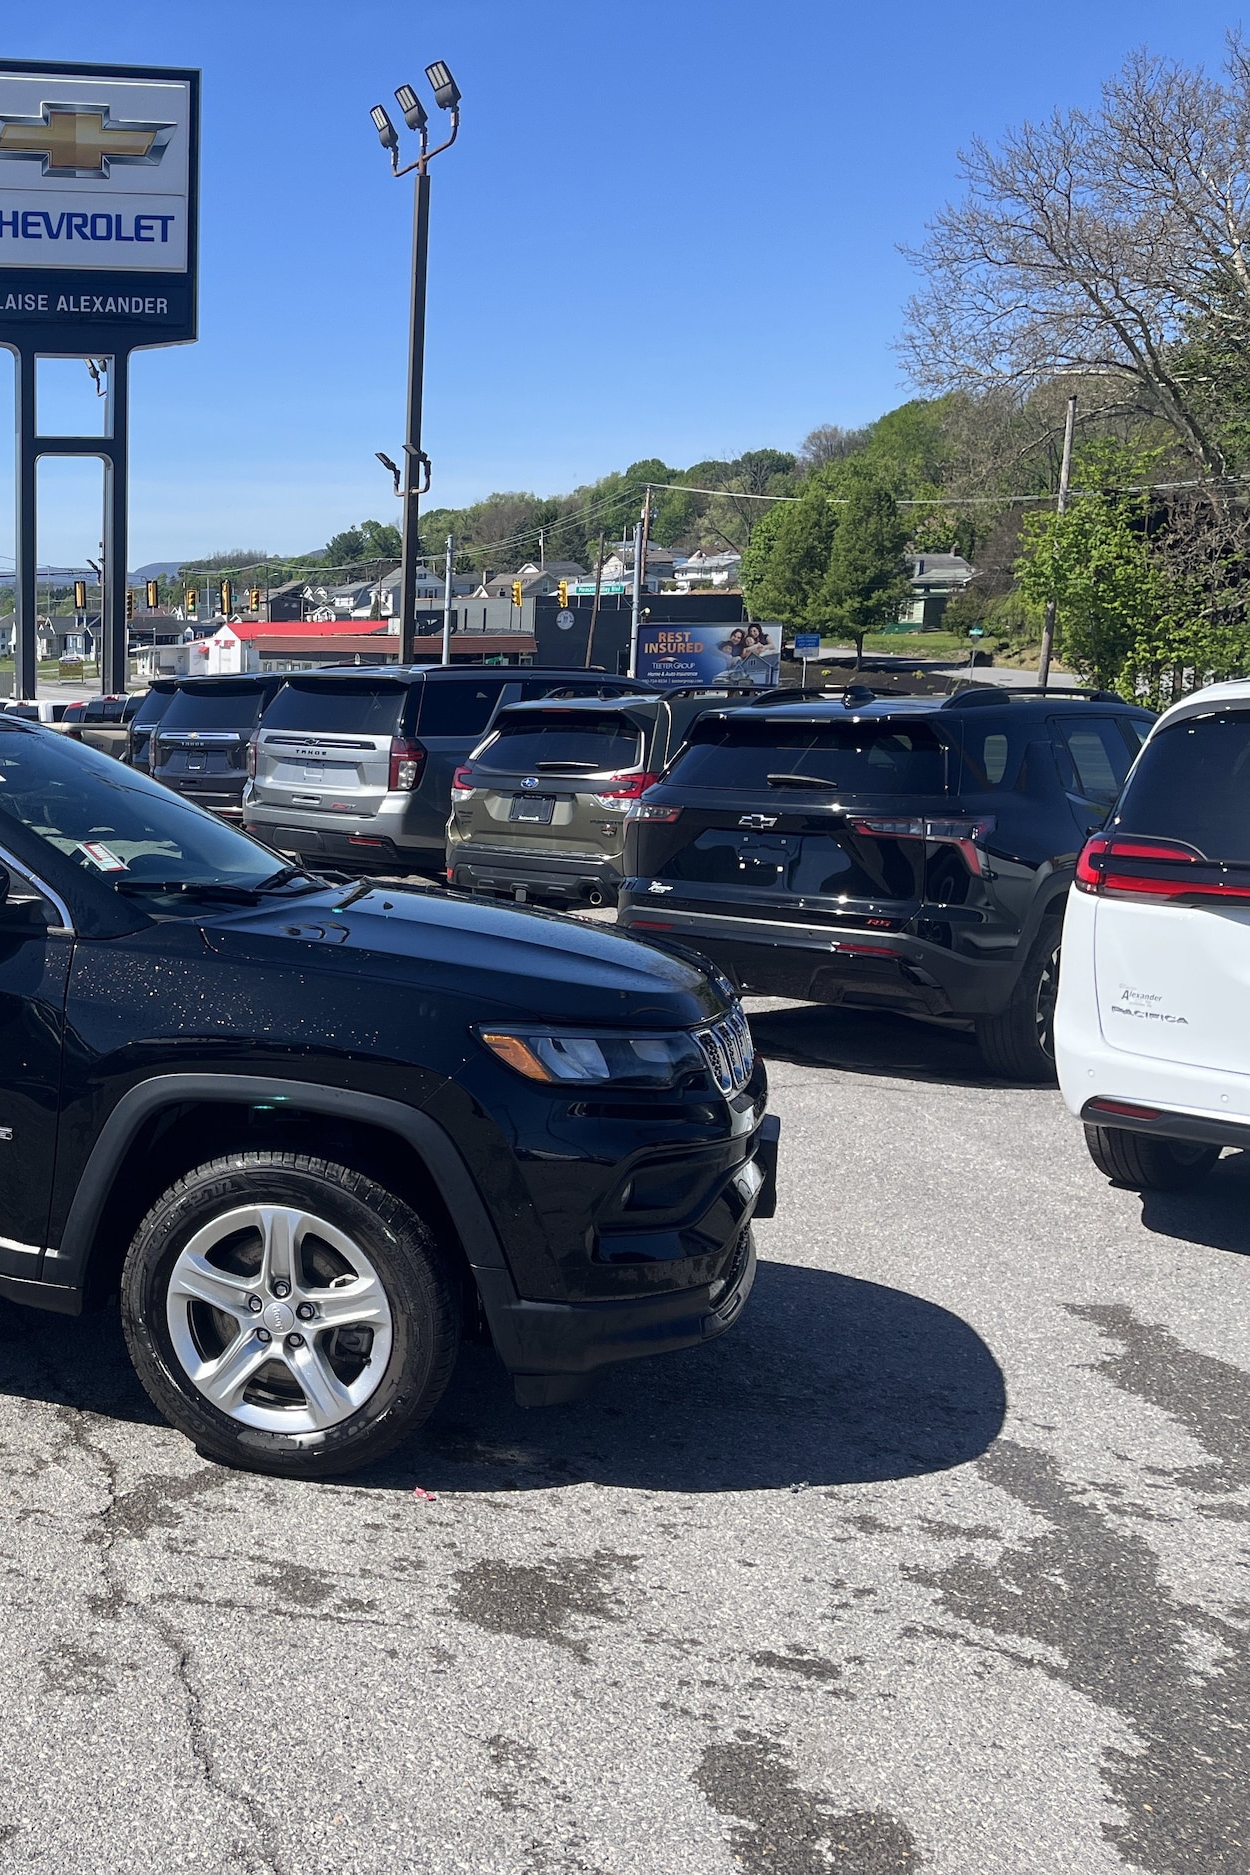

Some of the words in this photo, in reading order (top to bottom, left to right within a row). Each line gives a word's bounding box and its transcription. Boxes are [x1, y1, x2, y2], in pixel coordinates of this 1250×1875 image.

[56, 295, 168, 314] ALEXANDER
[658, 632, 691, 642] REST
[644, 642, 704, 653] INSURED
[1121, 990, 1162, 1002] Alexander
[1111, 1005, 1189, 1025] PACIFICA
